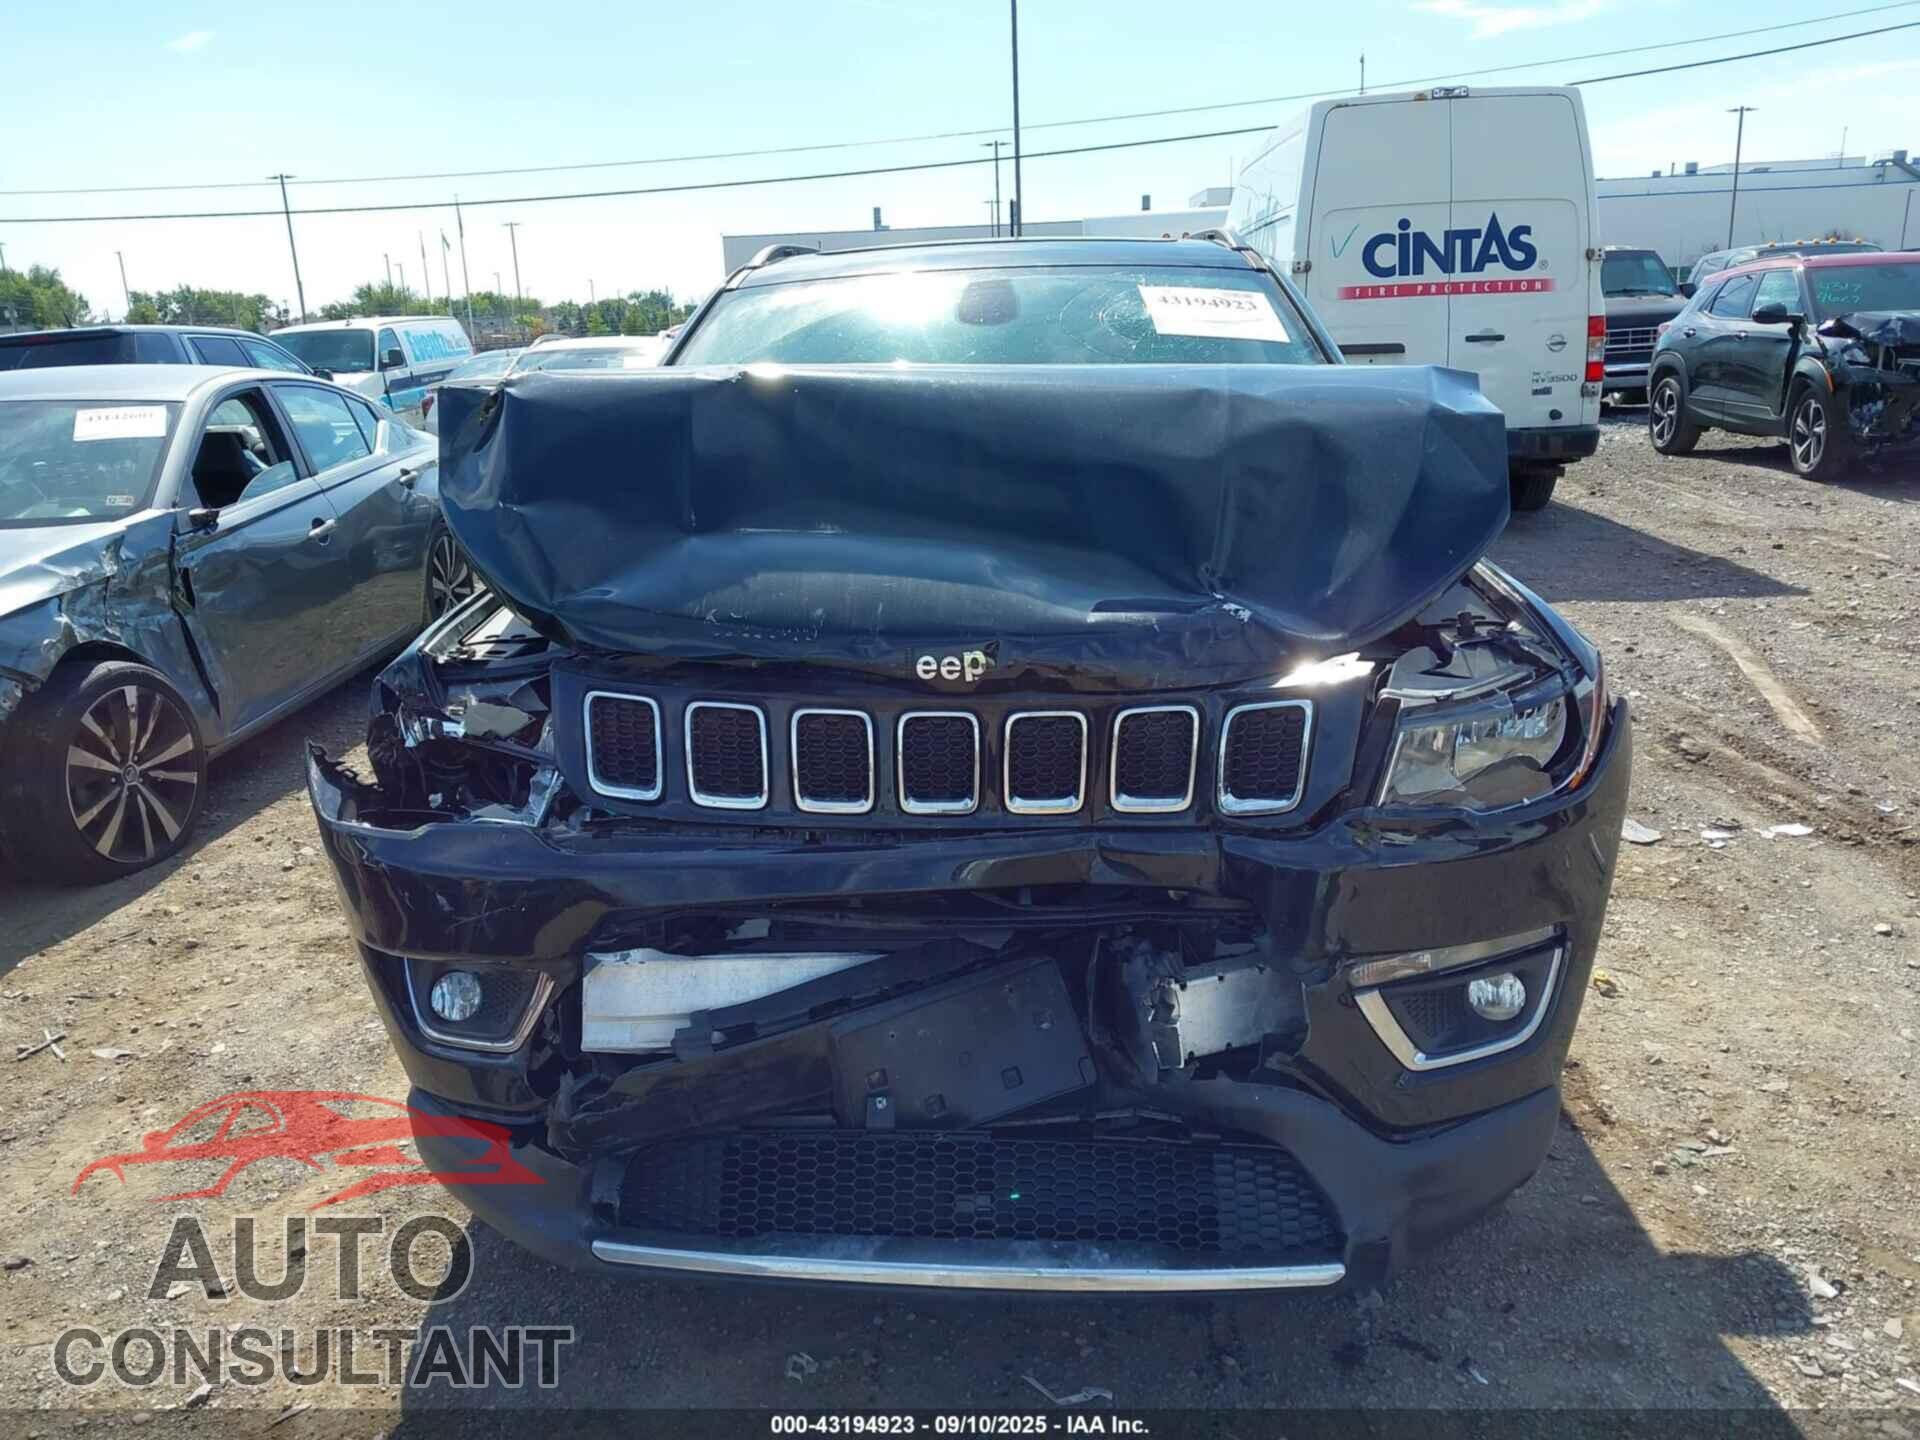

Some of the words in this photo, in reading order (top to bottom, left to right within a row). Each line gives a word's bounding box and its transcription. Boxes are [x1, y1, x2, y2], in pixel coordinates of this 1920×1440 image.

[1354, 285, 1399, 297] FIRE
[1416, 280, 1543, 294] PROTECTION
[916, 650, 987, 682] eep
